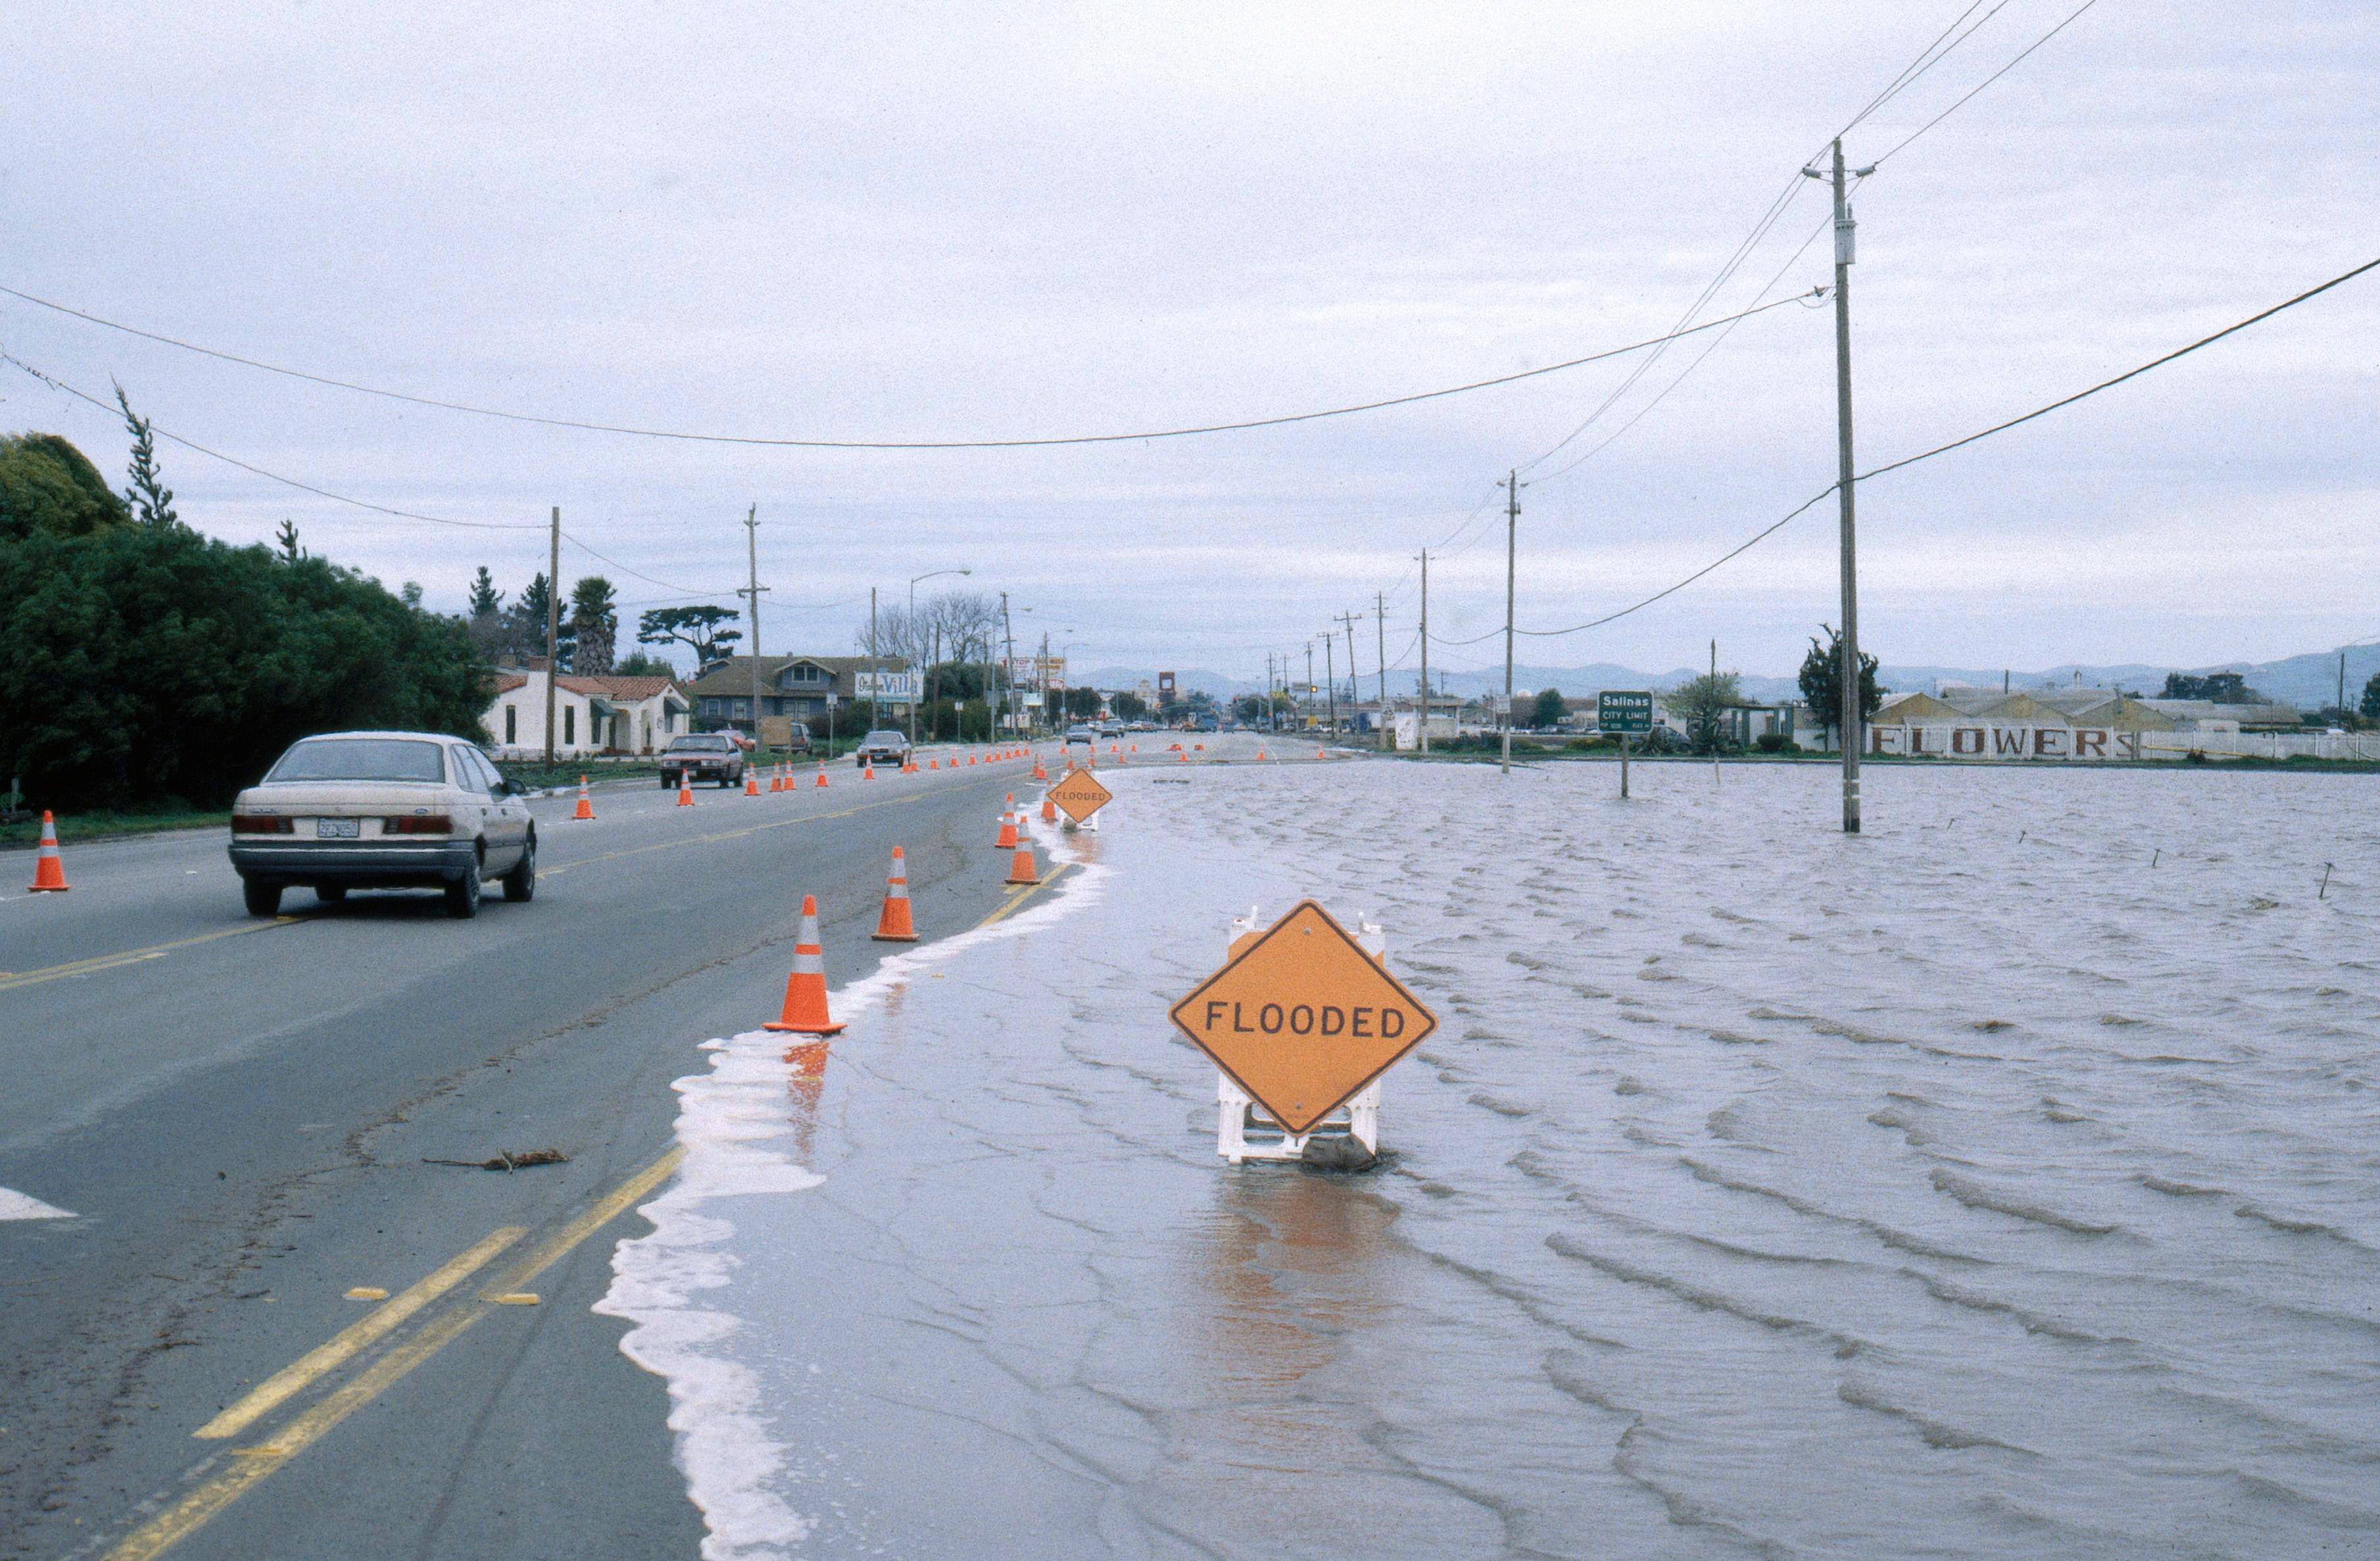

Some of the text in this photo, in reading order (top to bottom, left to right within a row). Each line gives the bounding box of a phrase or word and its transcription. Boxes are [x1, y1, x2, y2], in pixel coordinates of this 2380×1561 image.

[1603, 696, 1649, 706] Salinas
[1603, 711, 1622, 719] CITY
[1872, 727, 2133, 757] FLOWERS
[1056, 792, 1105, 801] FLOODED
[1205, 1001, 1405, 1038] FLOODED
